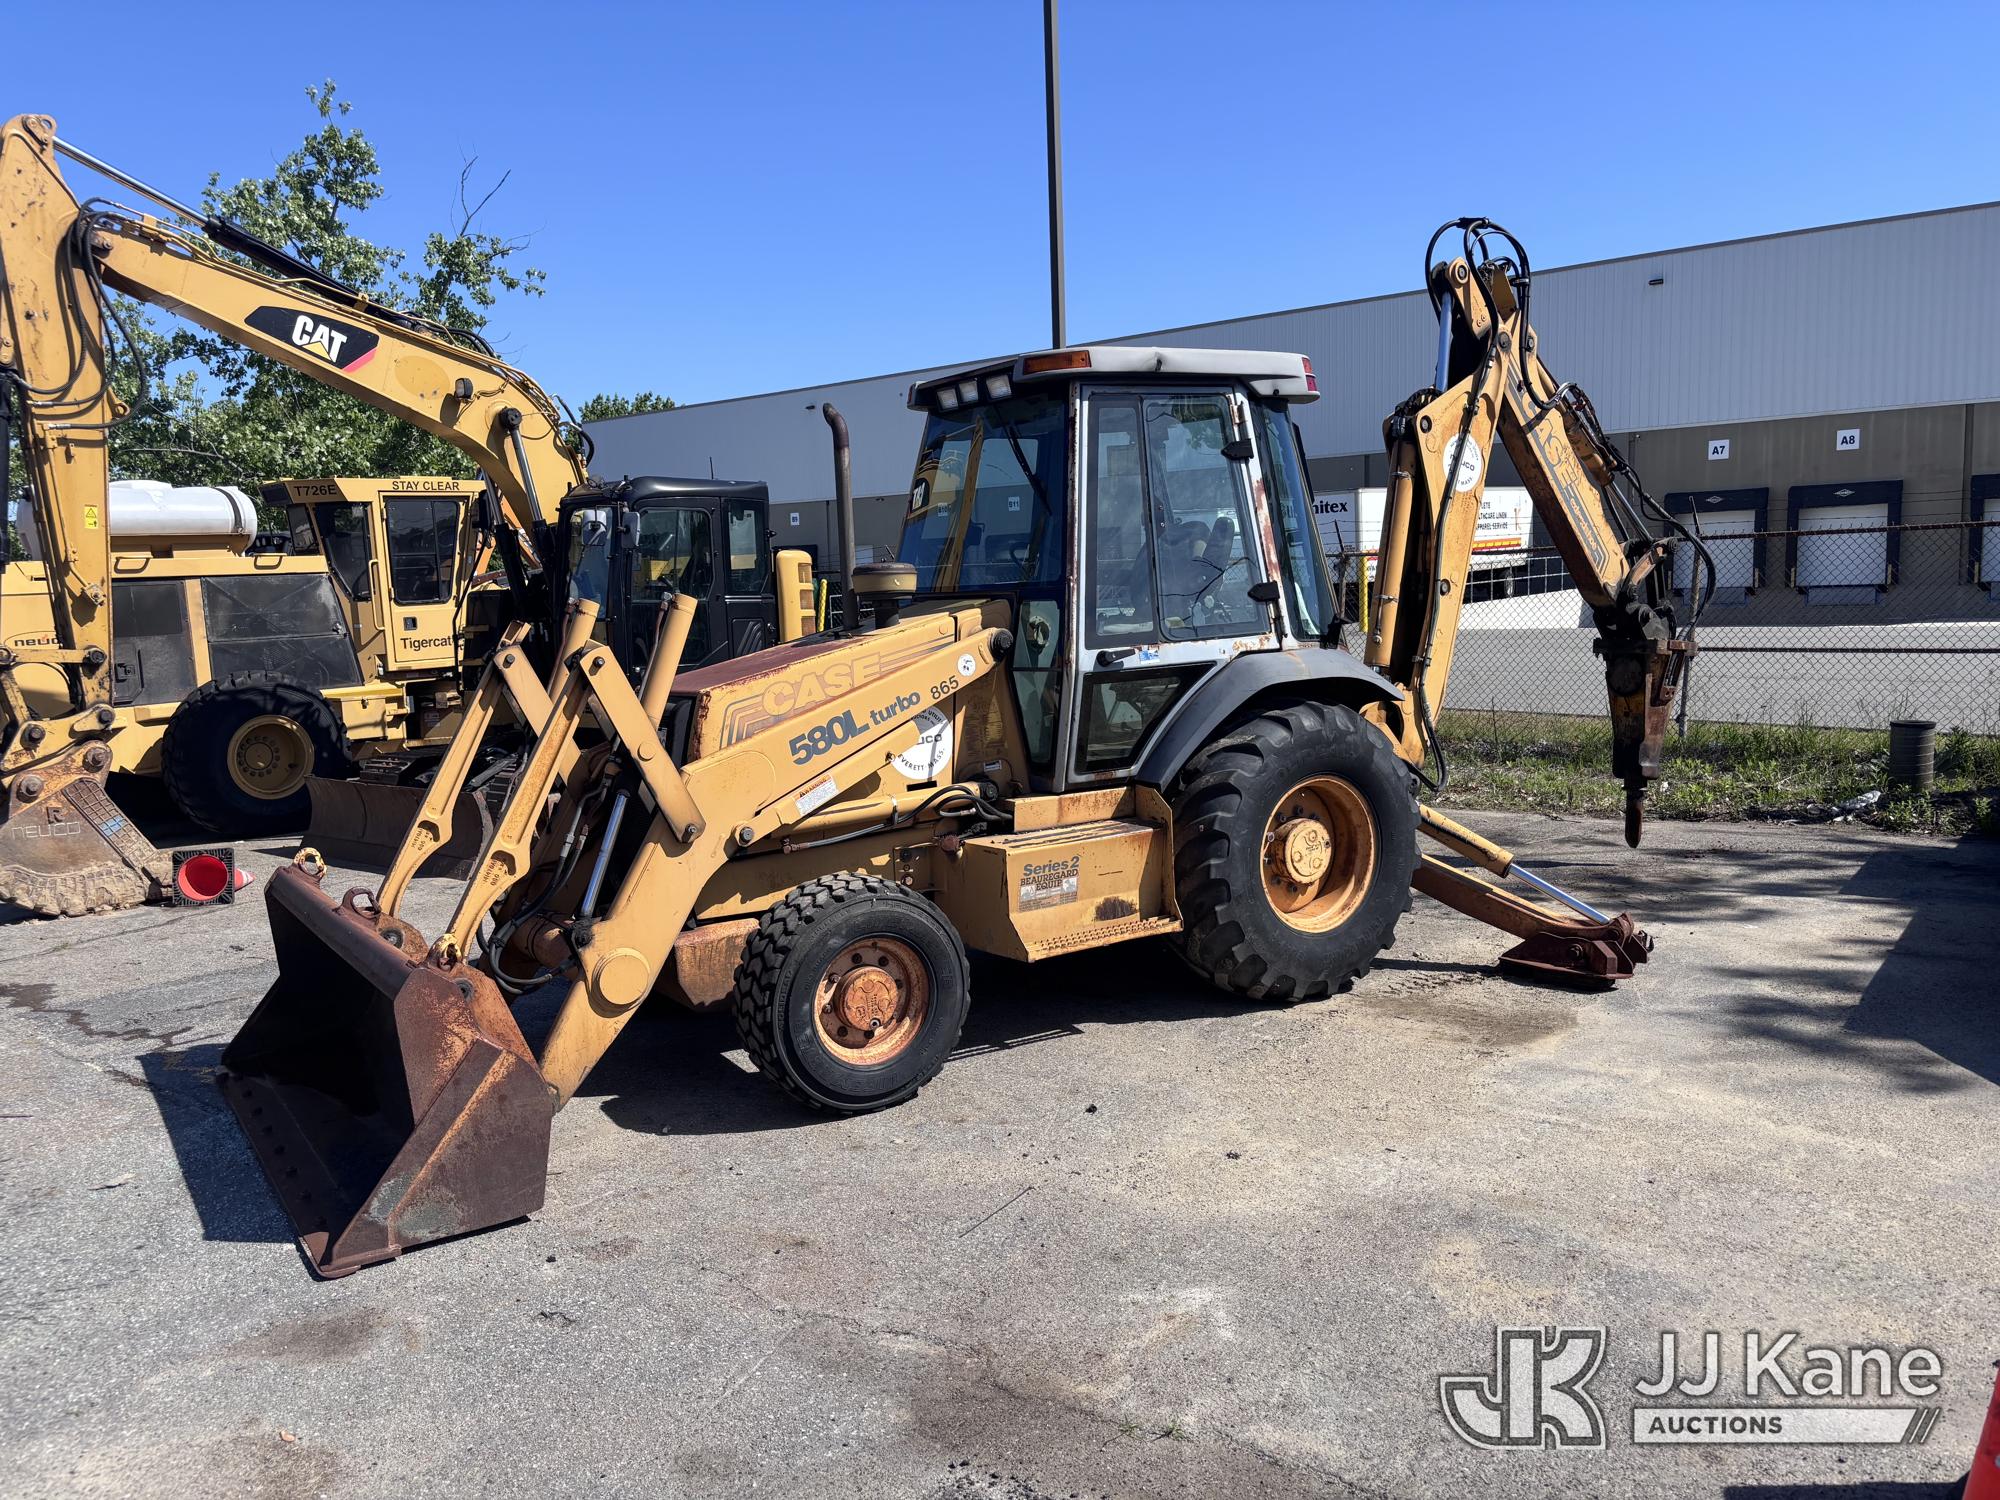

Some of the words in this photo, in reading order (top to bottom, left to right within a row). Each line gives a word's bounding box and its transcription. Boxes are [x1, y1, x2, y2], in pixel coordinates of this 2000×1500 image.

[292, 315, 348, 363] CAT
[1840, 435, 1856, 445] A8
[1712, 445, 1726, 455] A7
[294, 484, 337, 497] T726E
[392, 481, 419, 491] STAY
[423, 481, 460, 491] CLEAR
[1312, 500, 1348, 515] nitex
[400, 635, 451, 652] Tigercat
[762, 652, 881, 716] CASE
[930, 674, 960, 700] 865
[789, 709, 871, 766] 580L
[870, 691, 921, 726] turbo
[1022, 860, 1070, 877] Series
[1069, 855, 1080, 869] 2
[1020, 868, 1079, 887] BEAUREGARD
